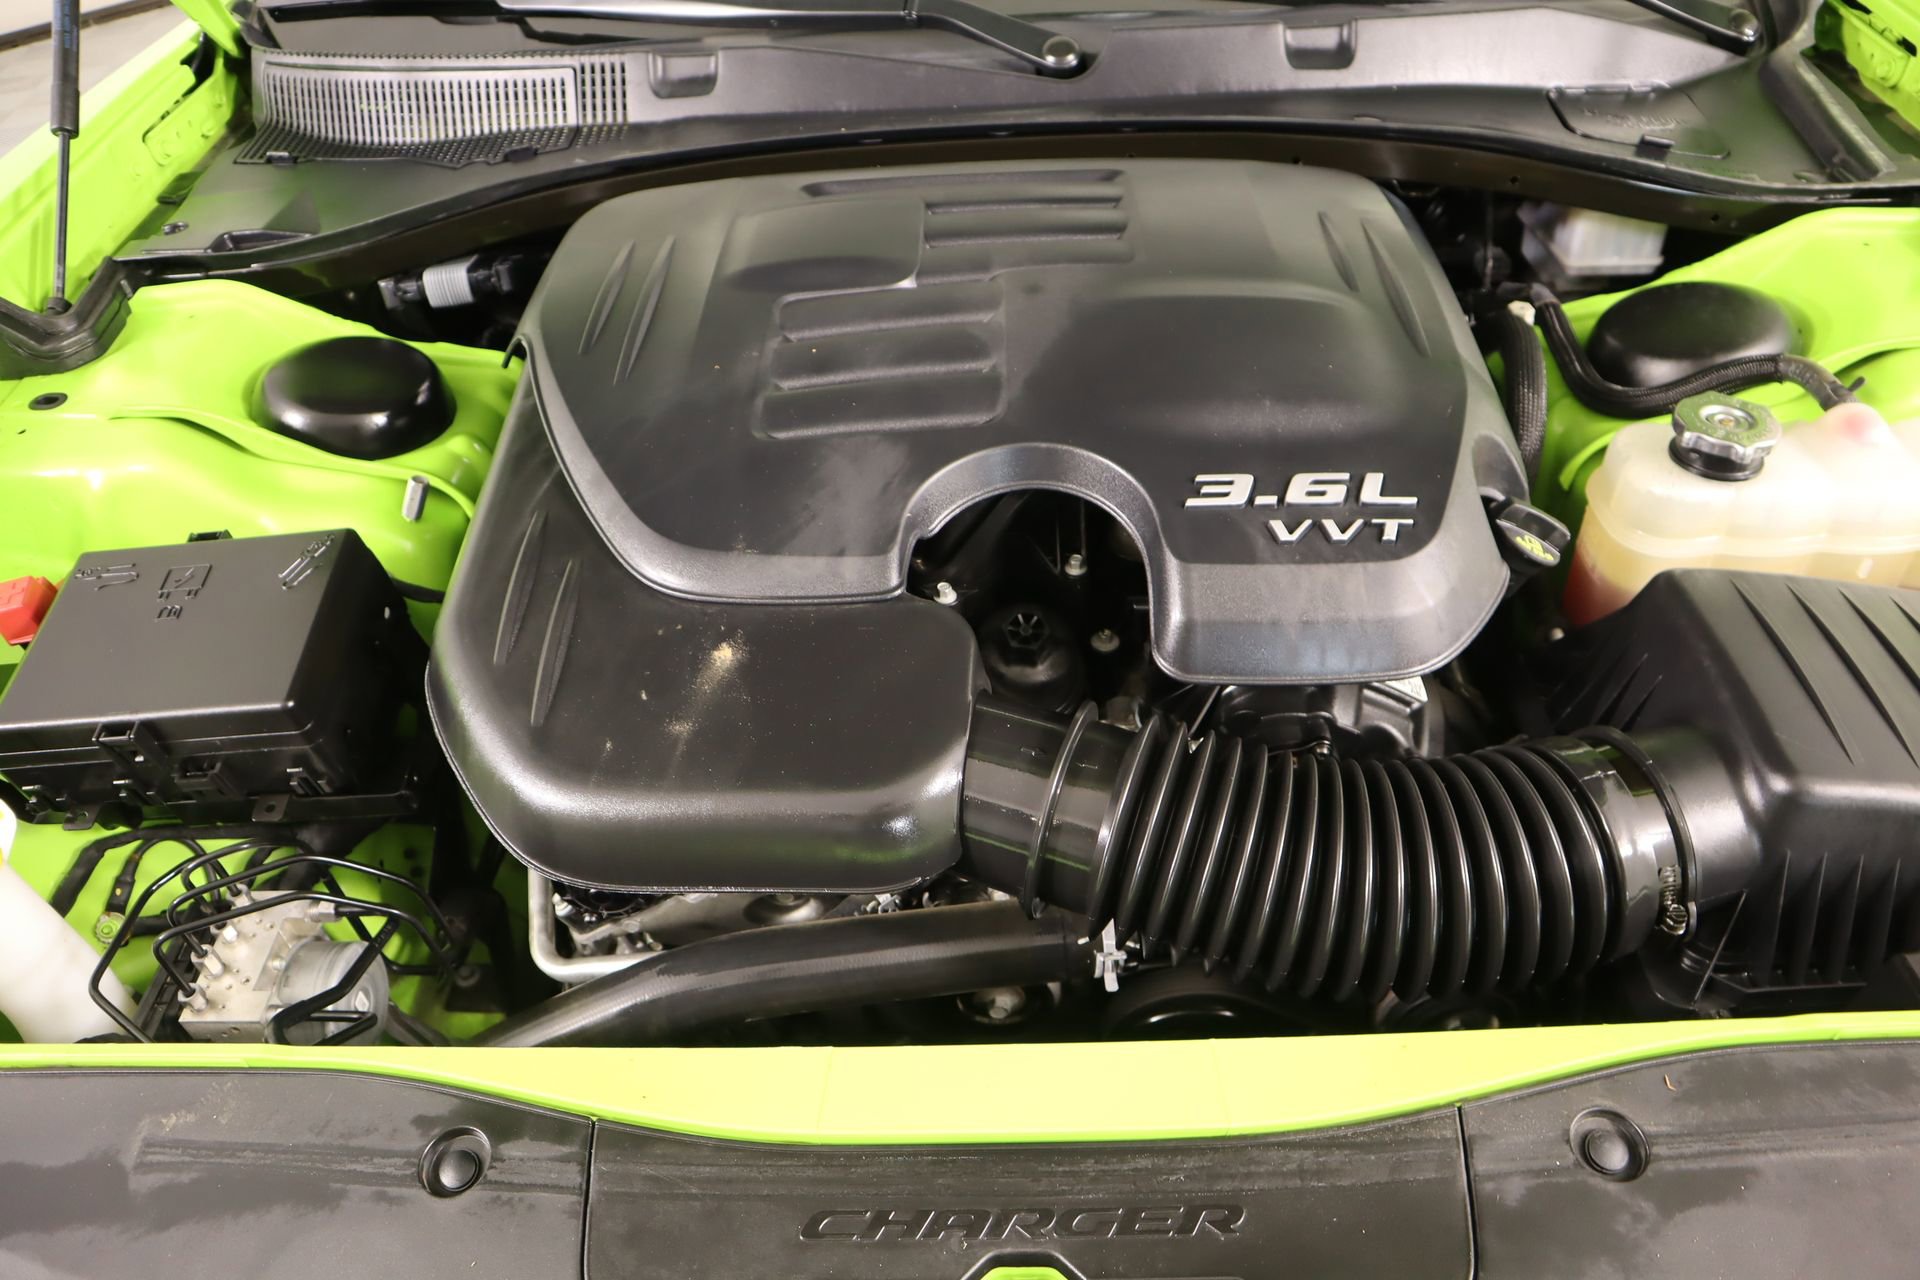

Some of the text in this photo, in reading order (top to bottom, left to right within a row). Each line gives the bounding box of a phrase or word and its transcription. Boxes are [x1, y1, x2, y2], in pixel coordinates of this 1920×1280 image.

[1184, 472, 1418, 509] 3.6L
[1267, 518, 1414, 544] VVT
[799, 1204, 1247, 1241] CHARGER
